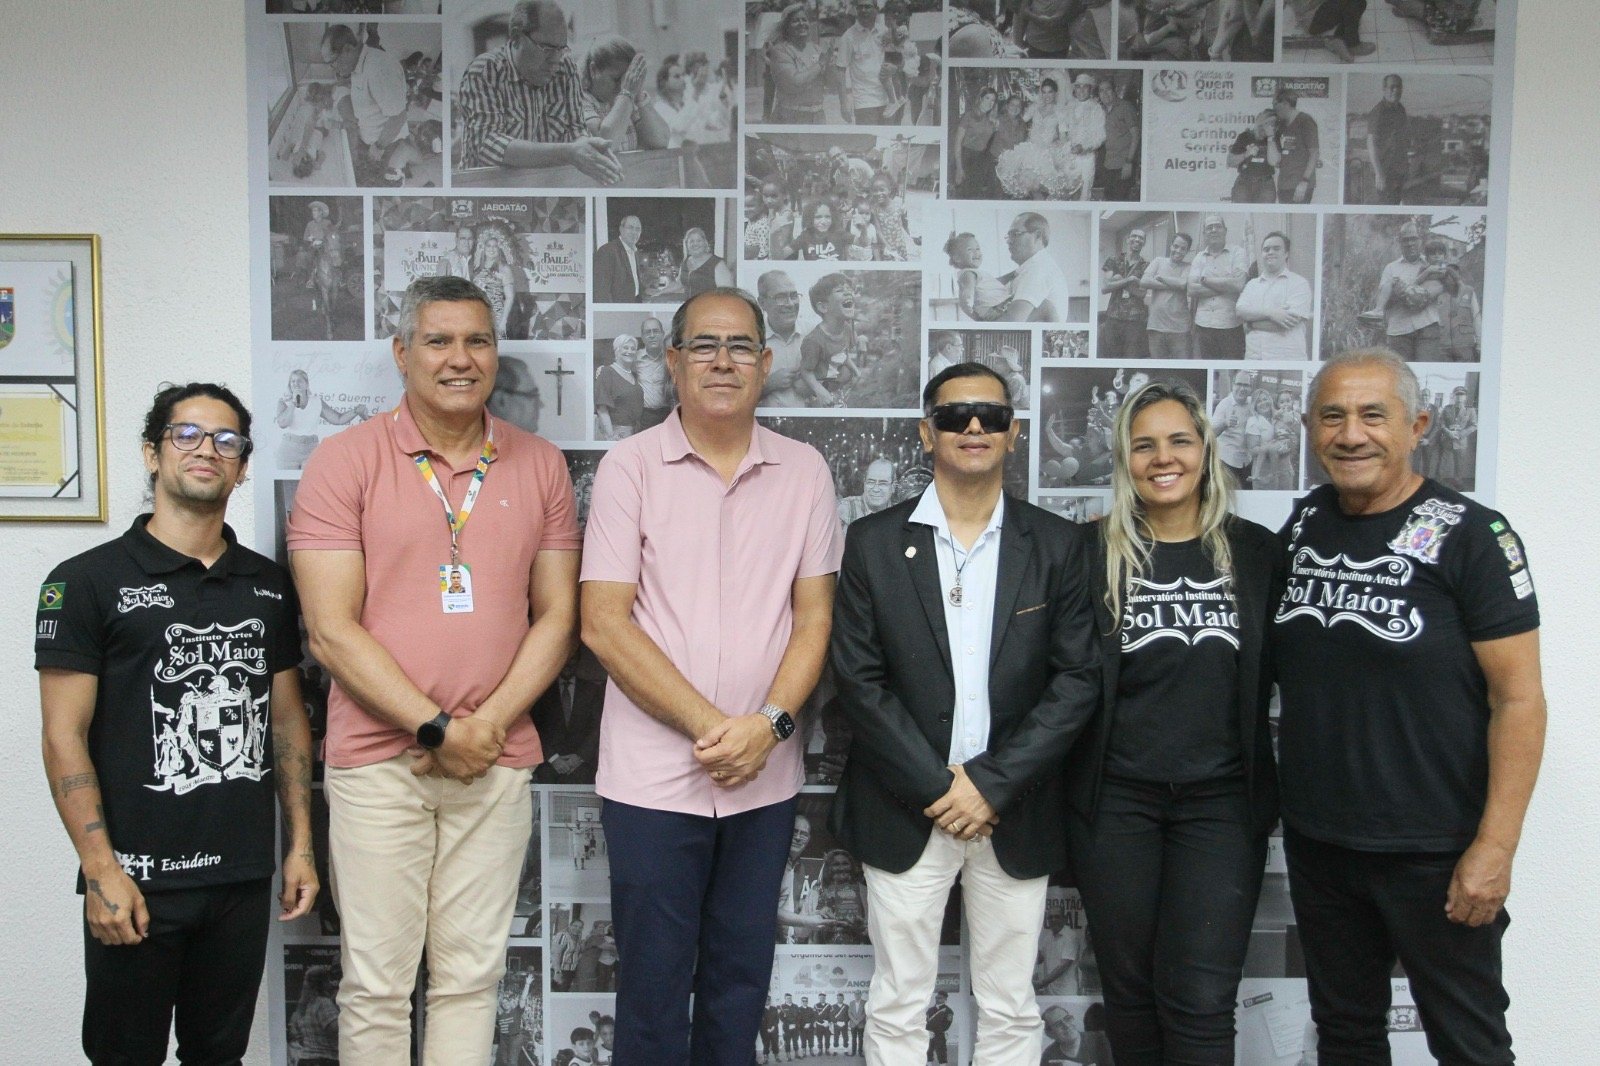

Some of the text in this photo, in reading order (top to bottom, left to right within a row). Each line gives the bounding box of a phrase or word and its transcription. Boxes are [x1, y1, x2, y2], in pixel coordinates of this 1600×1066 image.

[1196, 79, 1234, 90] Quem
[1196, 88, 1234, 100] Cuida
[1197, 113, 1256, 124] Acolhim
[1181, 128, 1237, 139] Carinho
[1164, 157, 1217, 172] Alegria
[481, 202, 528, 213] JABOATÃO
[808, 242, 836, 255] FILA
[541, 252, 569, 264] BAILE
[401, 260, 437, 272] MUNIC
[338, 393, 370, 403] Quem
[1337, 570, 1372, 582] Instituto
[1373, 574, 1399, 586] Artes
[122, 594, 140, 605] Sol
[142, 593, 169, 603] Maior
[1127, 592, 1183, 603] onservatório
[1185, 590, 1221, 601] Instituto
[1281, 578, 1407, 616] Sol Maior
[1170, 603, 1240, 629] Maio
[181, 632, 253, 644] Instituto Artes
[169, 641, 266, 666] Sol Maior
[161, 851, 221, 871] Escudeiro
